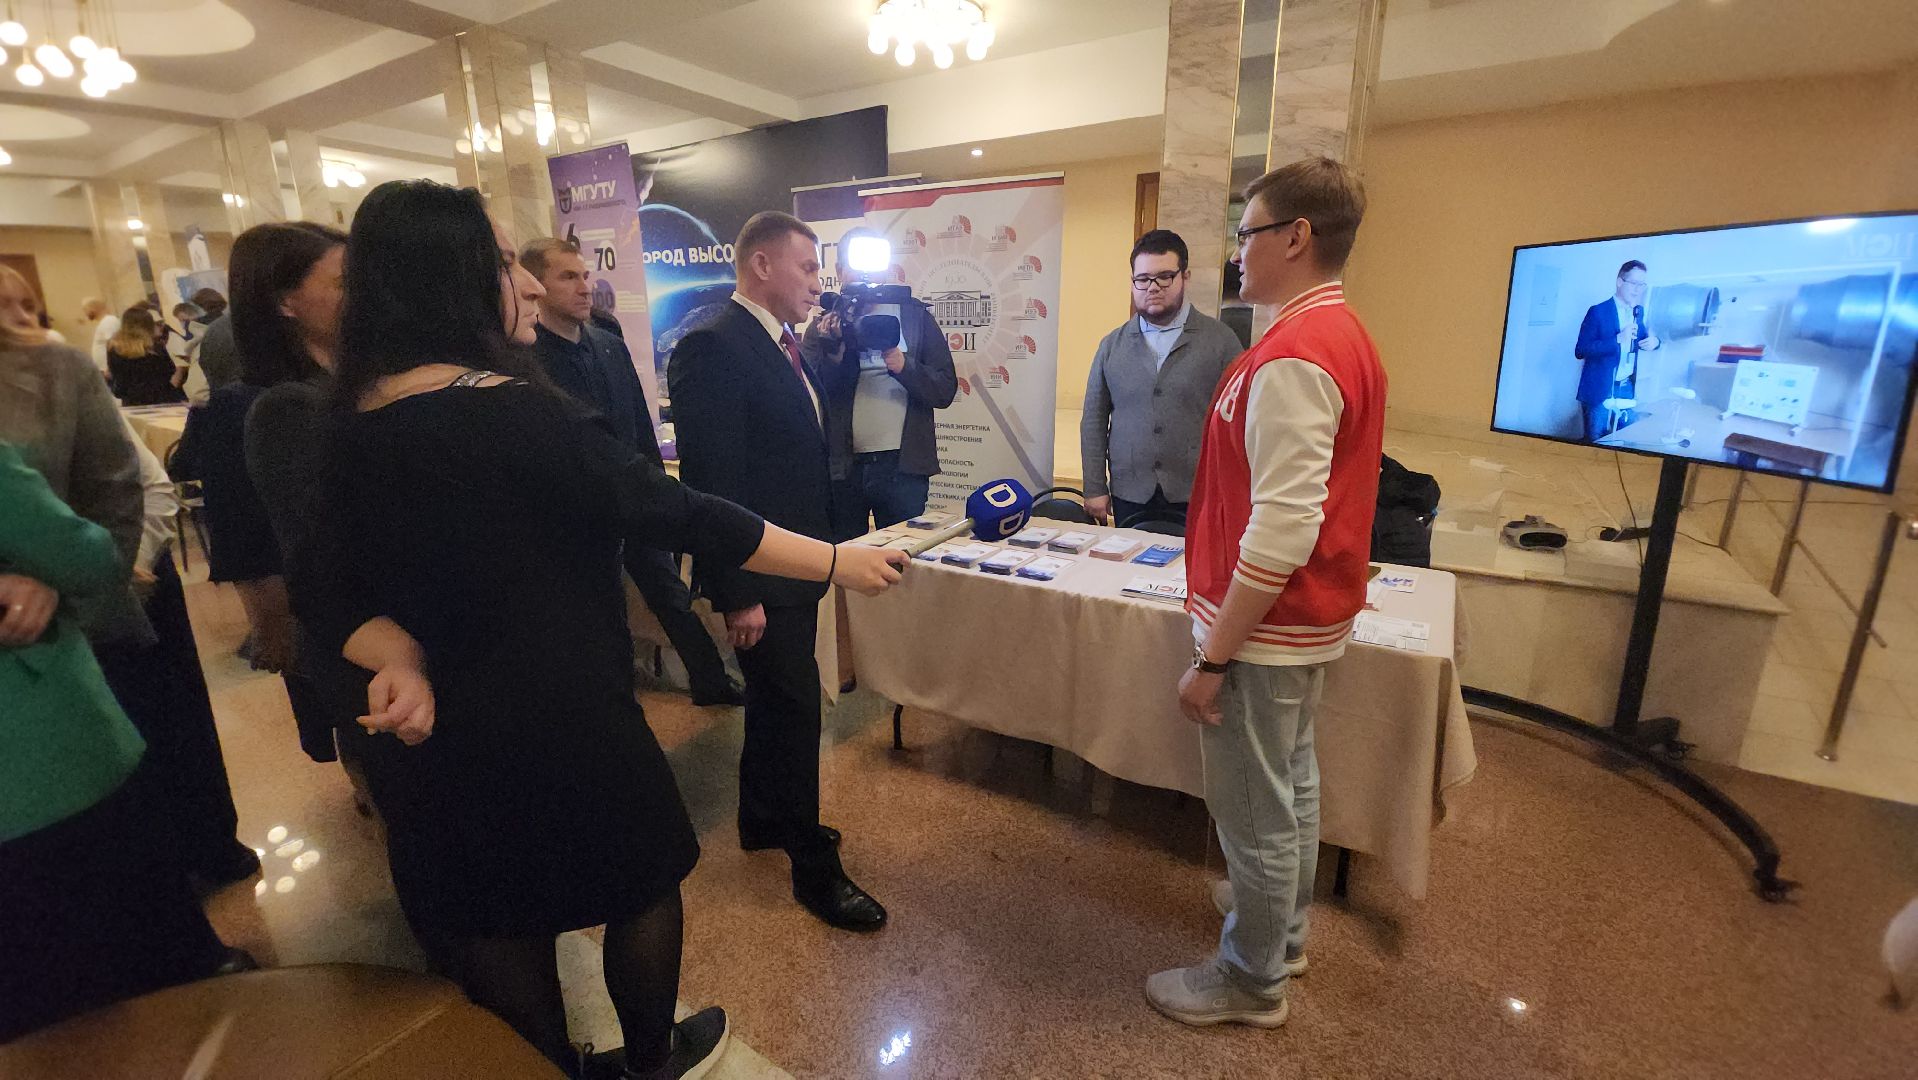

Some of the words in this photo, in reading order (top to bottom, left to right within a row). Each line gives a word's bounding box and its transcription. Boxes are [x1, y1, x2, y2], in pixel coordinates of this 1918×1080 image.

[571, 180, 616, 202] МГУТУ
[594, 246, 616, 271] 70
[642, 248, 686, 267] ОРОД
[688, 243, 737, 264] ВЫСО
[946, 332, 977, 351] ЭИ
[954, 424, 991, 432] ЭНЕРГЕТИКА
